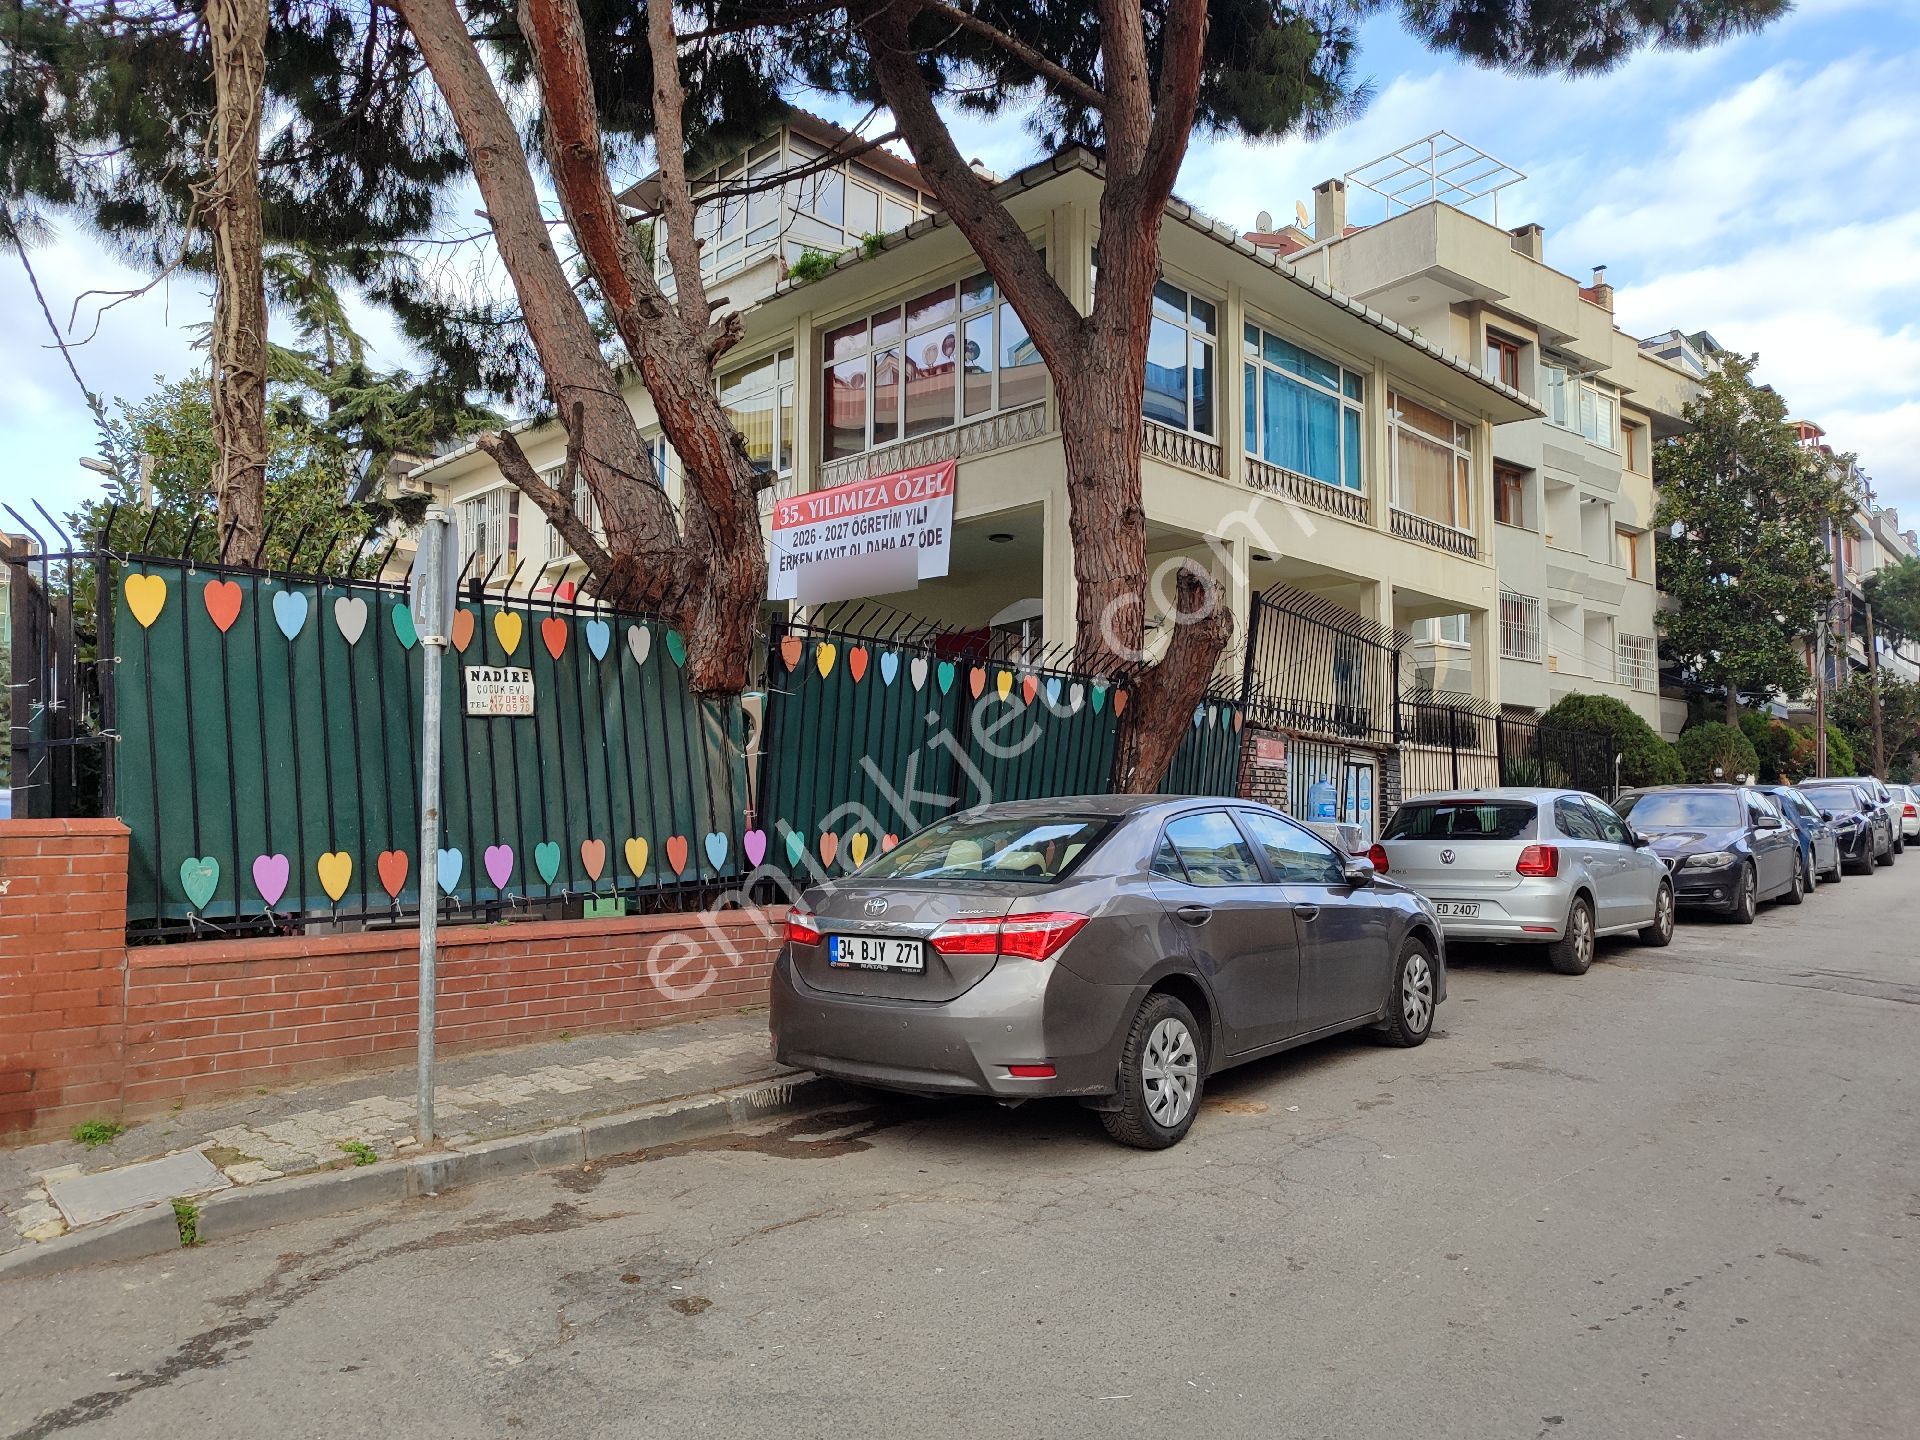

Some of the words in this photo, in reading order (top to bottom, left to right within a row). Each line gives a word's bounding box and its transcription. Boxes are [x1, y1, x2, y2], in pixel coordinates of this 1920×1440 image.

[778, 504, 804, 526] 35.
[808, 485, 889, 519] YILIMIZA
[894, 472, 947, 501] ÖZEL
[792, 528, 816, 548] 2026
[824, 522, 849, 542] 2027
[851, 508, 902, 537] ÖĞRETİM
[905, 505, 928, 527] YILI
[918, 527, 943, 549] ÖDE
[470, 668, 530, 683] NADİRE
[1436, 903, 1449, 914] ED
[1452, 904, 1478, 915] 2407
[839, 939, 855, 960] 34
[861, 940, 886, 962] BJY
[895, 942, 920, 965] 271
